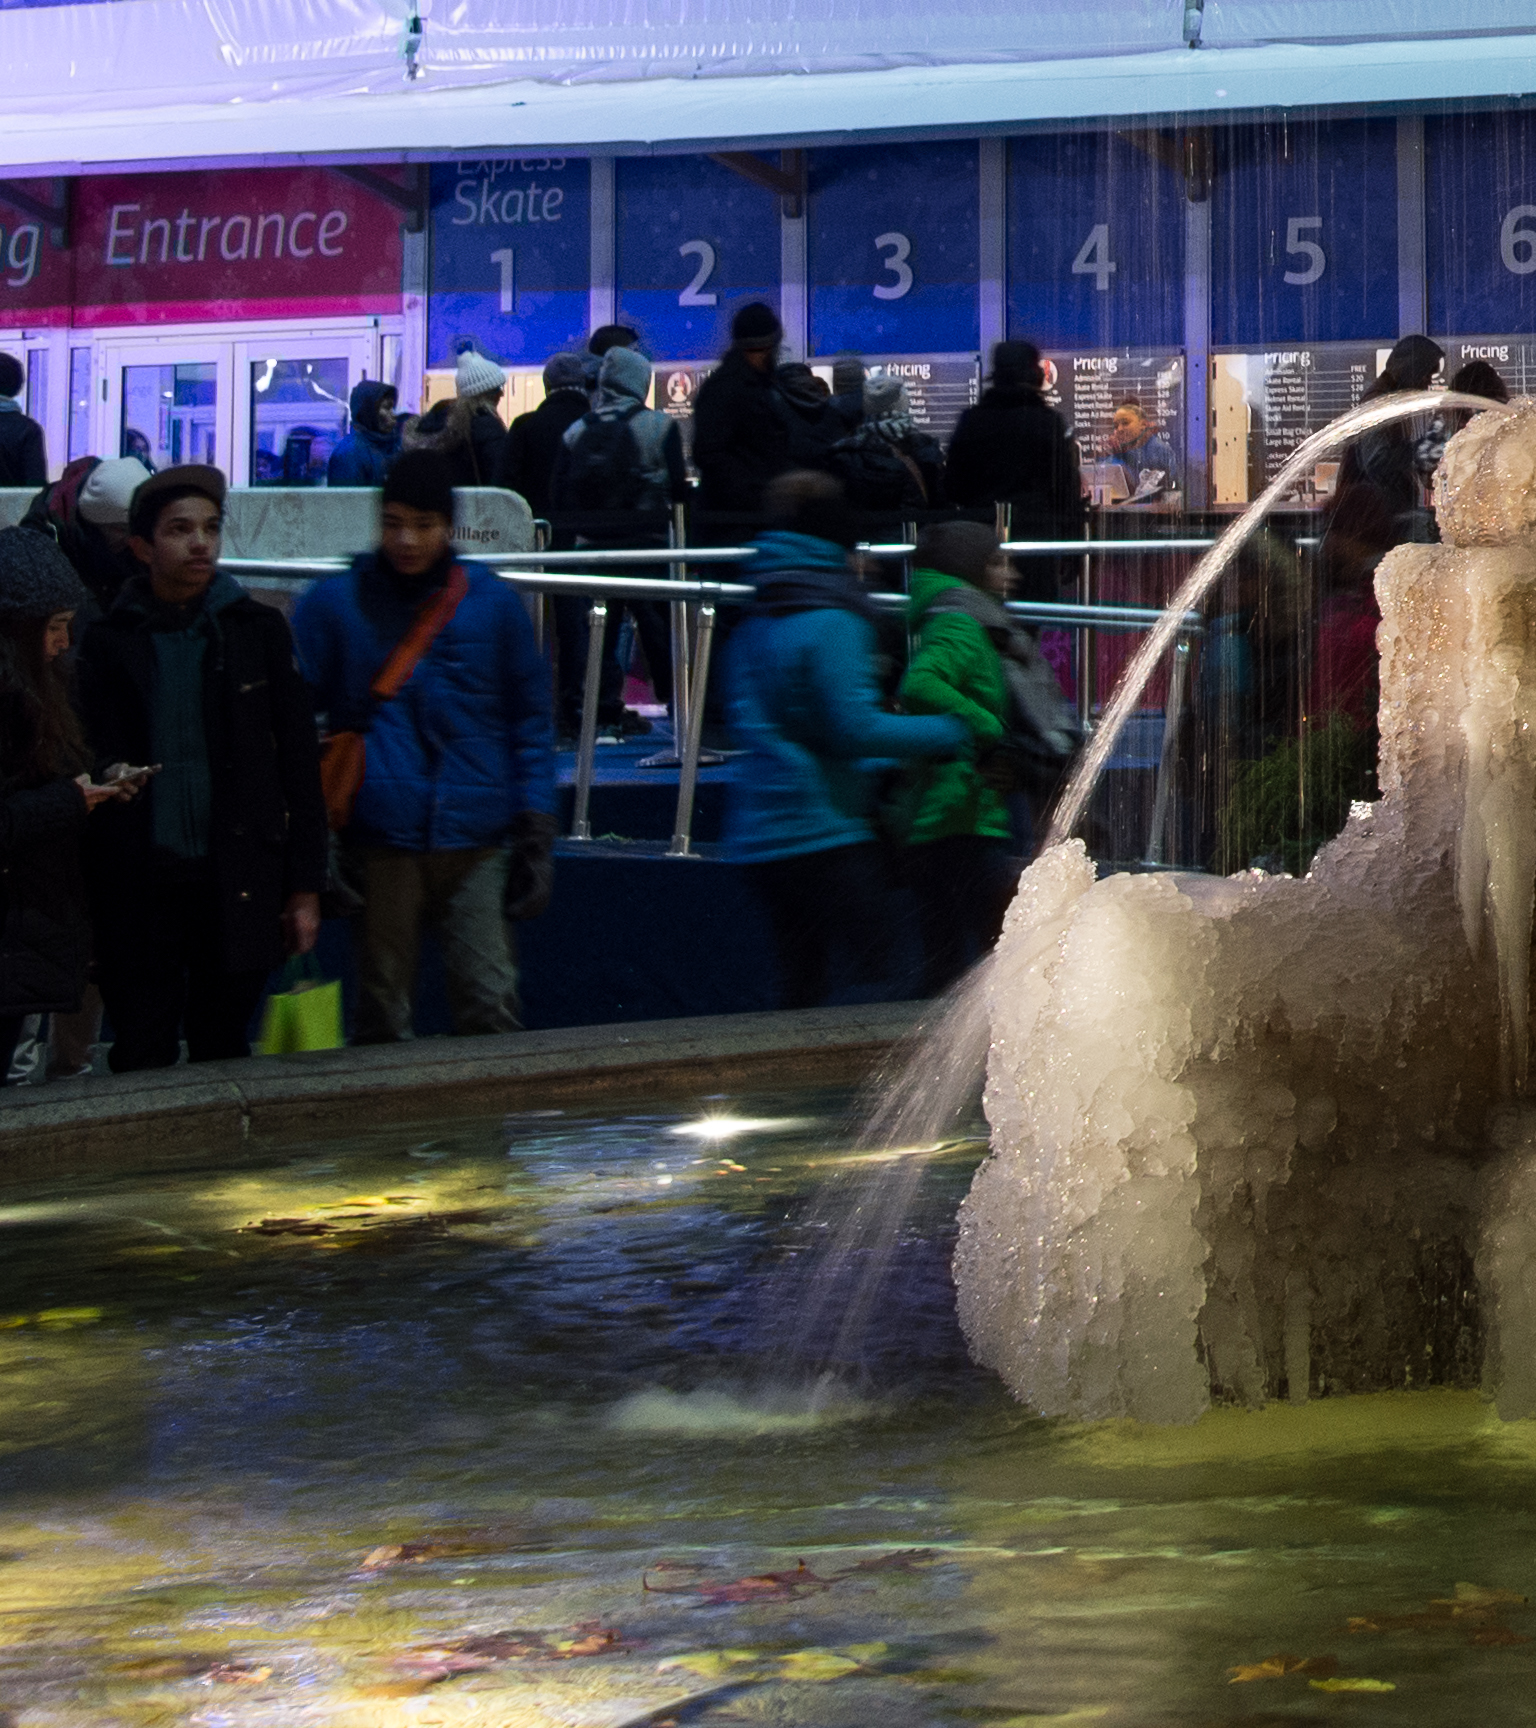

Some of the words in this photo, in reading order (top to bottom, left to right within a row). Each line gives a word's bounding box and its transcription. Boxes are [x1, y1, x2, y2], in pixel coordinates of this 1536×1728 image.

[105, 202, 349, 265] Entrance
[451, 178, 564, 225] Skate
[490, 248, 514, 313] 1
[678, 240, 717, 306] 2
[873, 232, 914, 300] 3
[1071, 224, 1117, 291] 4
[1283, 216, 1327, 286] 5
[1073, 357, 1118, 373] Pricing
[1264, 351, 1310, 367] Pricing
[1461, 344, 1509, 362] Pricing
